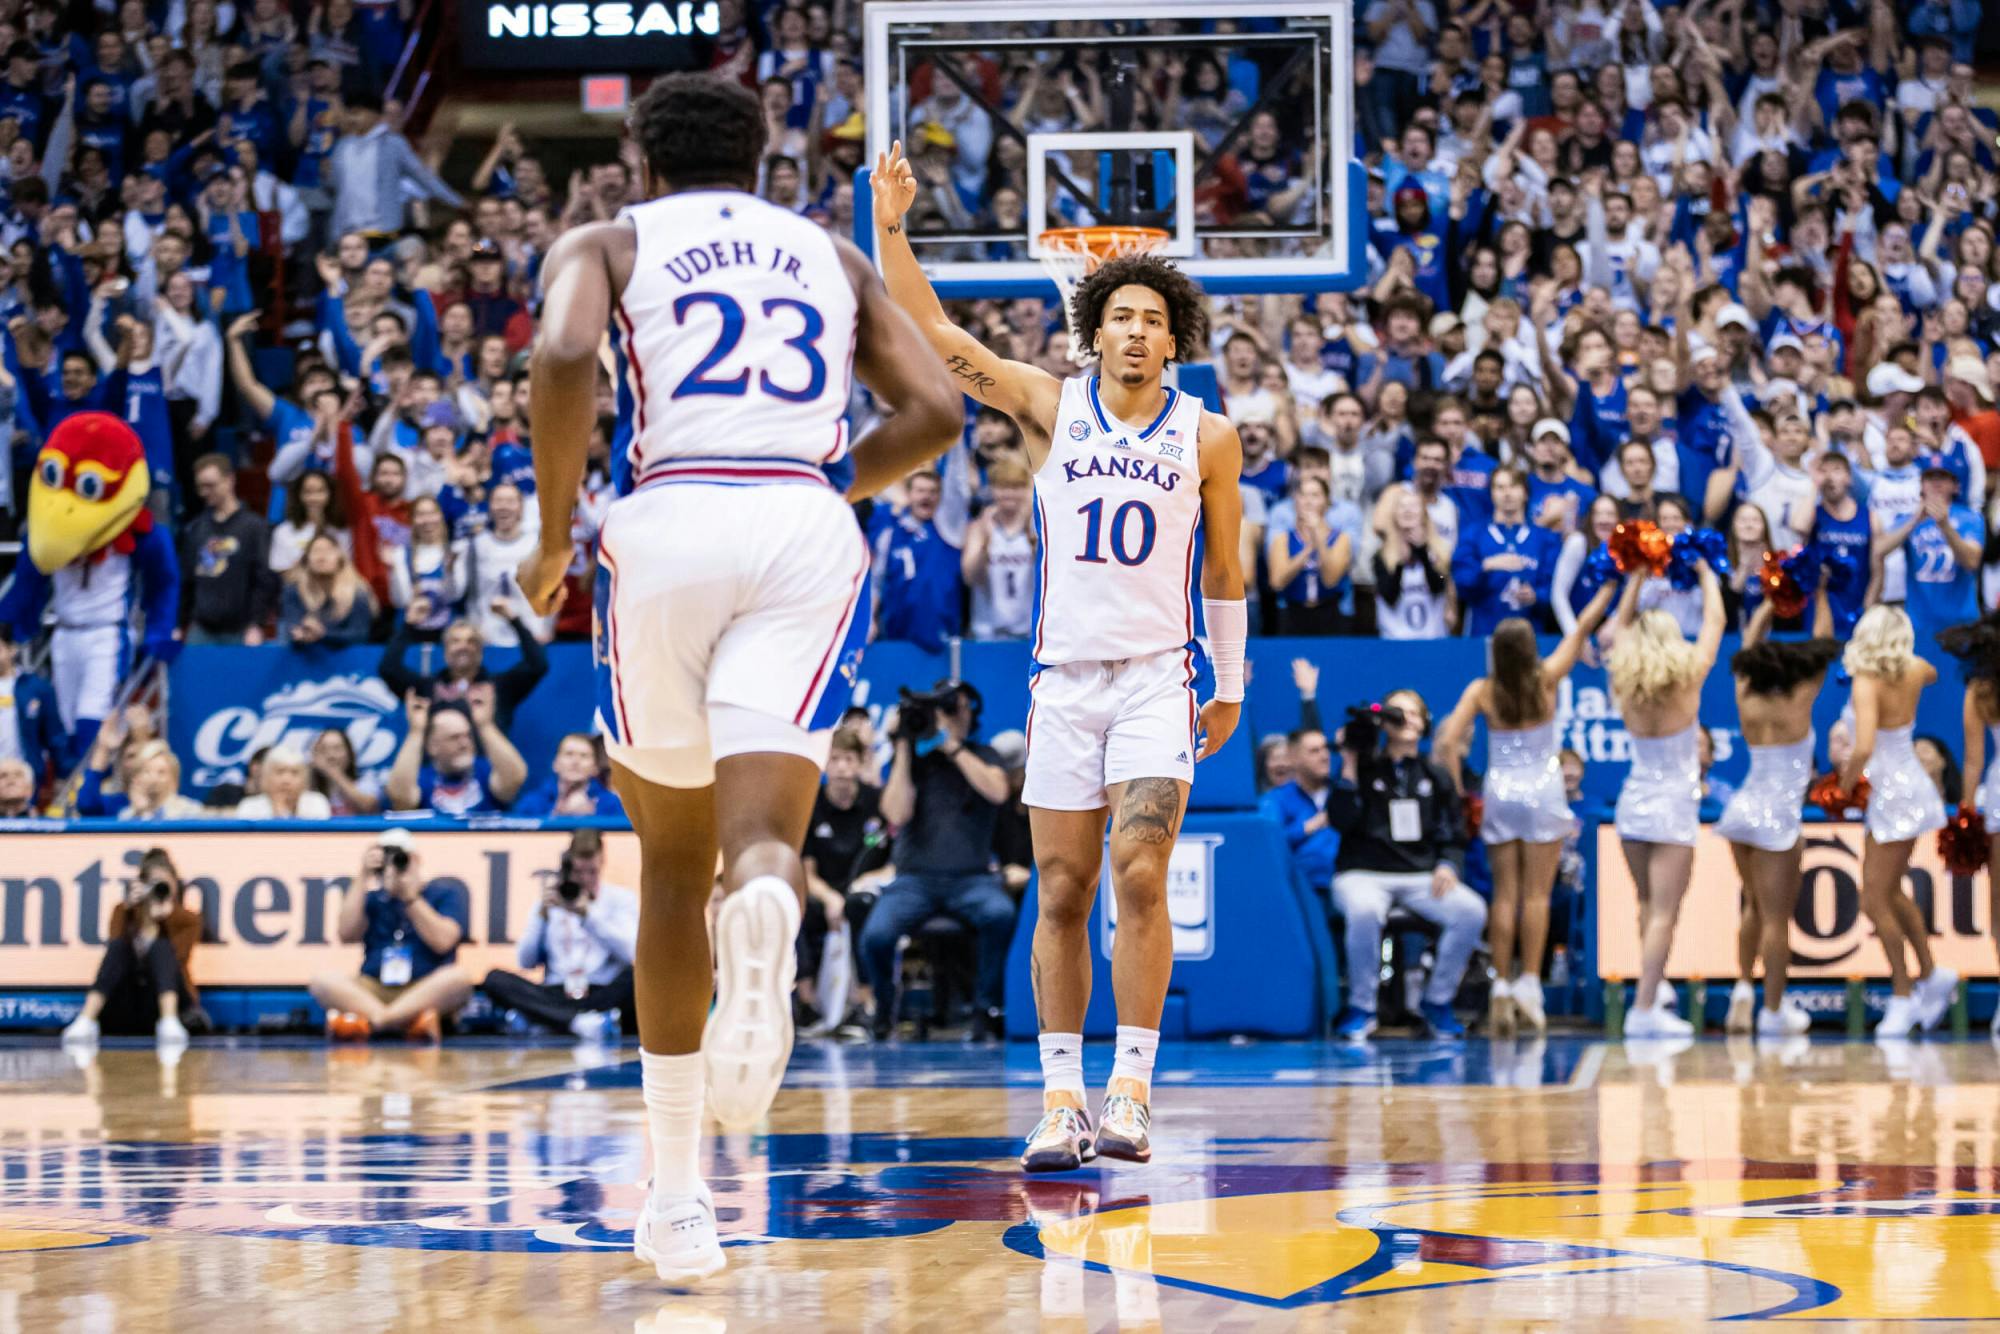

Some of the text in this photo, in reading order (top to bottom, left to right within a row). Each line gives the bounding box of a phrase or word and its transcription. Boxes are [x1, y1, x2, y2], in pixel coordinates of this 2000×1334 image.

[488, 2, 720, 37] NISSAN
[664, 241, 809, 289] UDEH JR.
[671, 292, 826, 403] 23
[945, 354, 997, 398] FEAR
[1062, 455, 1181, 492] KANSAS
[1074, 497, 1157, 567] 10
